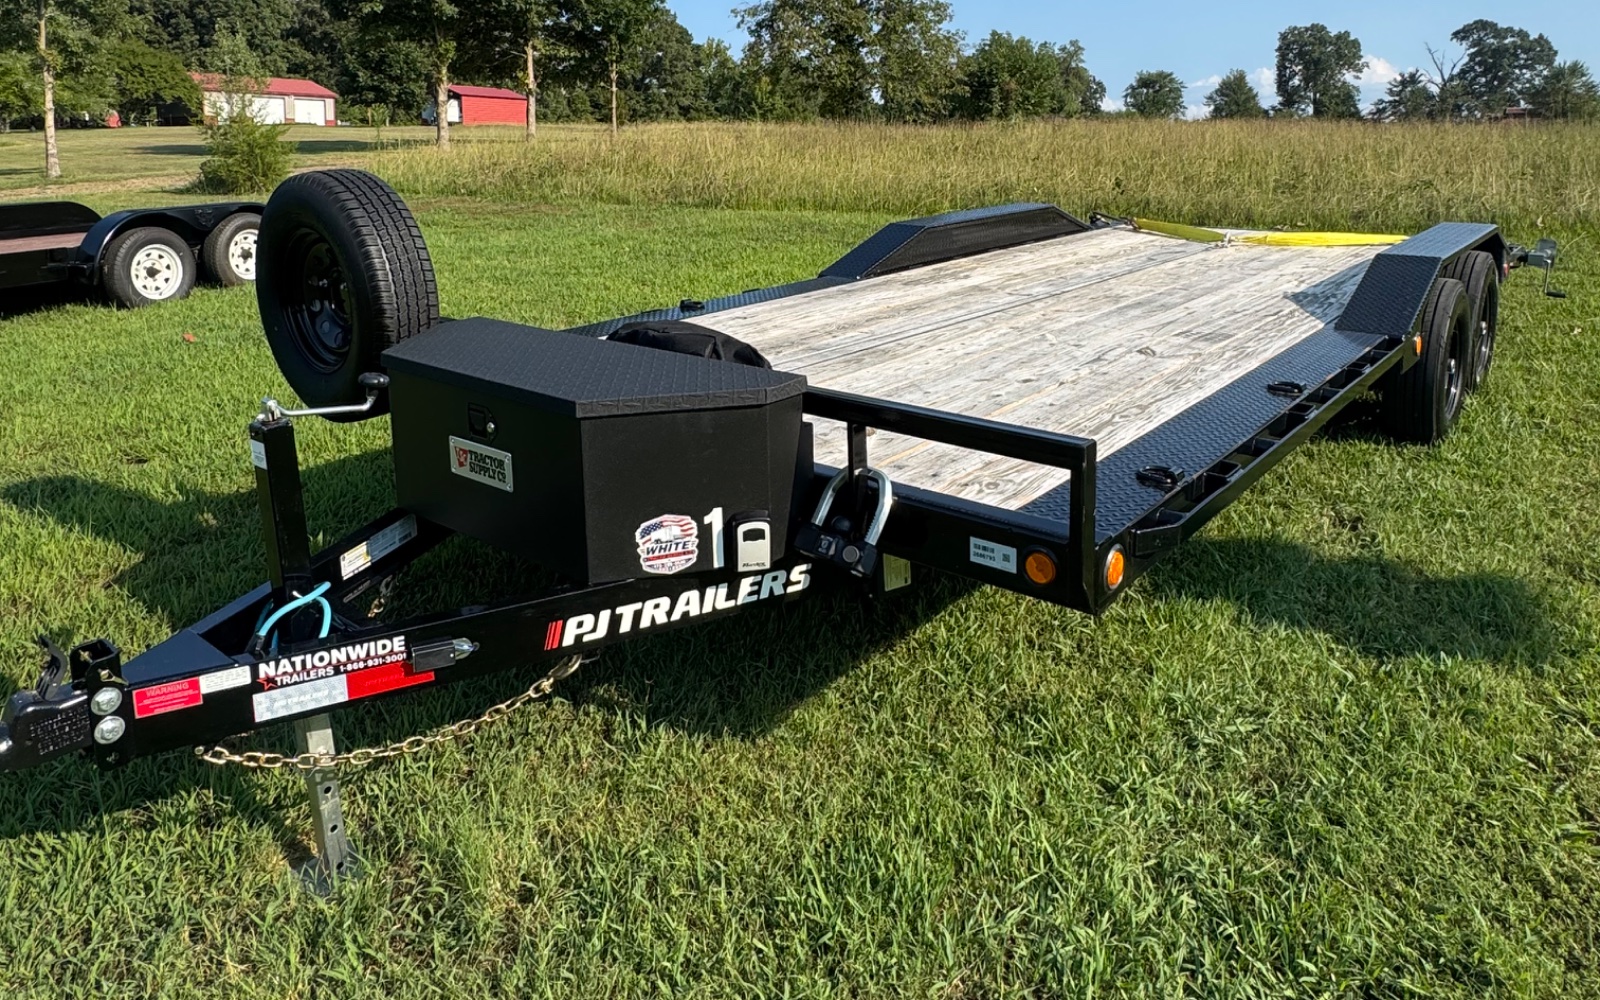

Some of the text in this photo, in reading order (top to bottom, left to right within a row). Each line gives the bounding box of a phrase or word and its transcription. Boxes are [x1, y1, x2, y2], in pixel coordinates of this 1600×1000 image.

[468, 450, 505, 471] TRACTOR
[469, 462, 496, 480] SUPPLY
[646, 540, 690, 556] WHITE
[703, 507, 725, 569] 1
[562, 563, 812, 647] PJ TRAILERS
[258, 635, 406, 679] NATIONWIDE
[275, 652, 408, 686] TRAILERS 1-866-931-3001
[146, 681, 190, 698] WARNING
